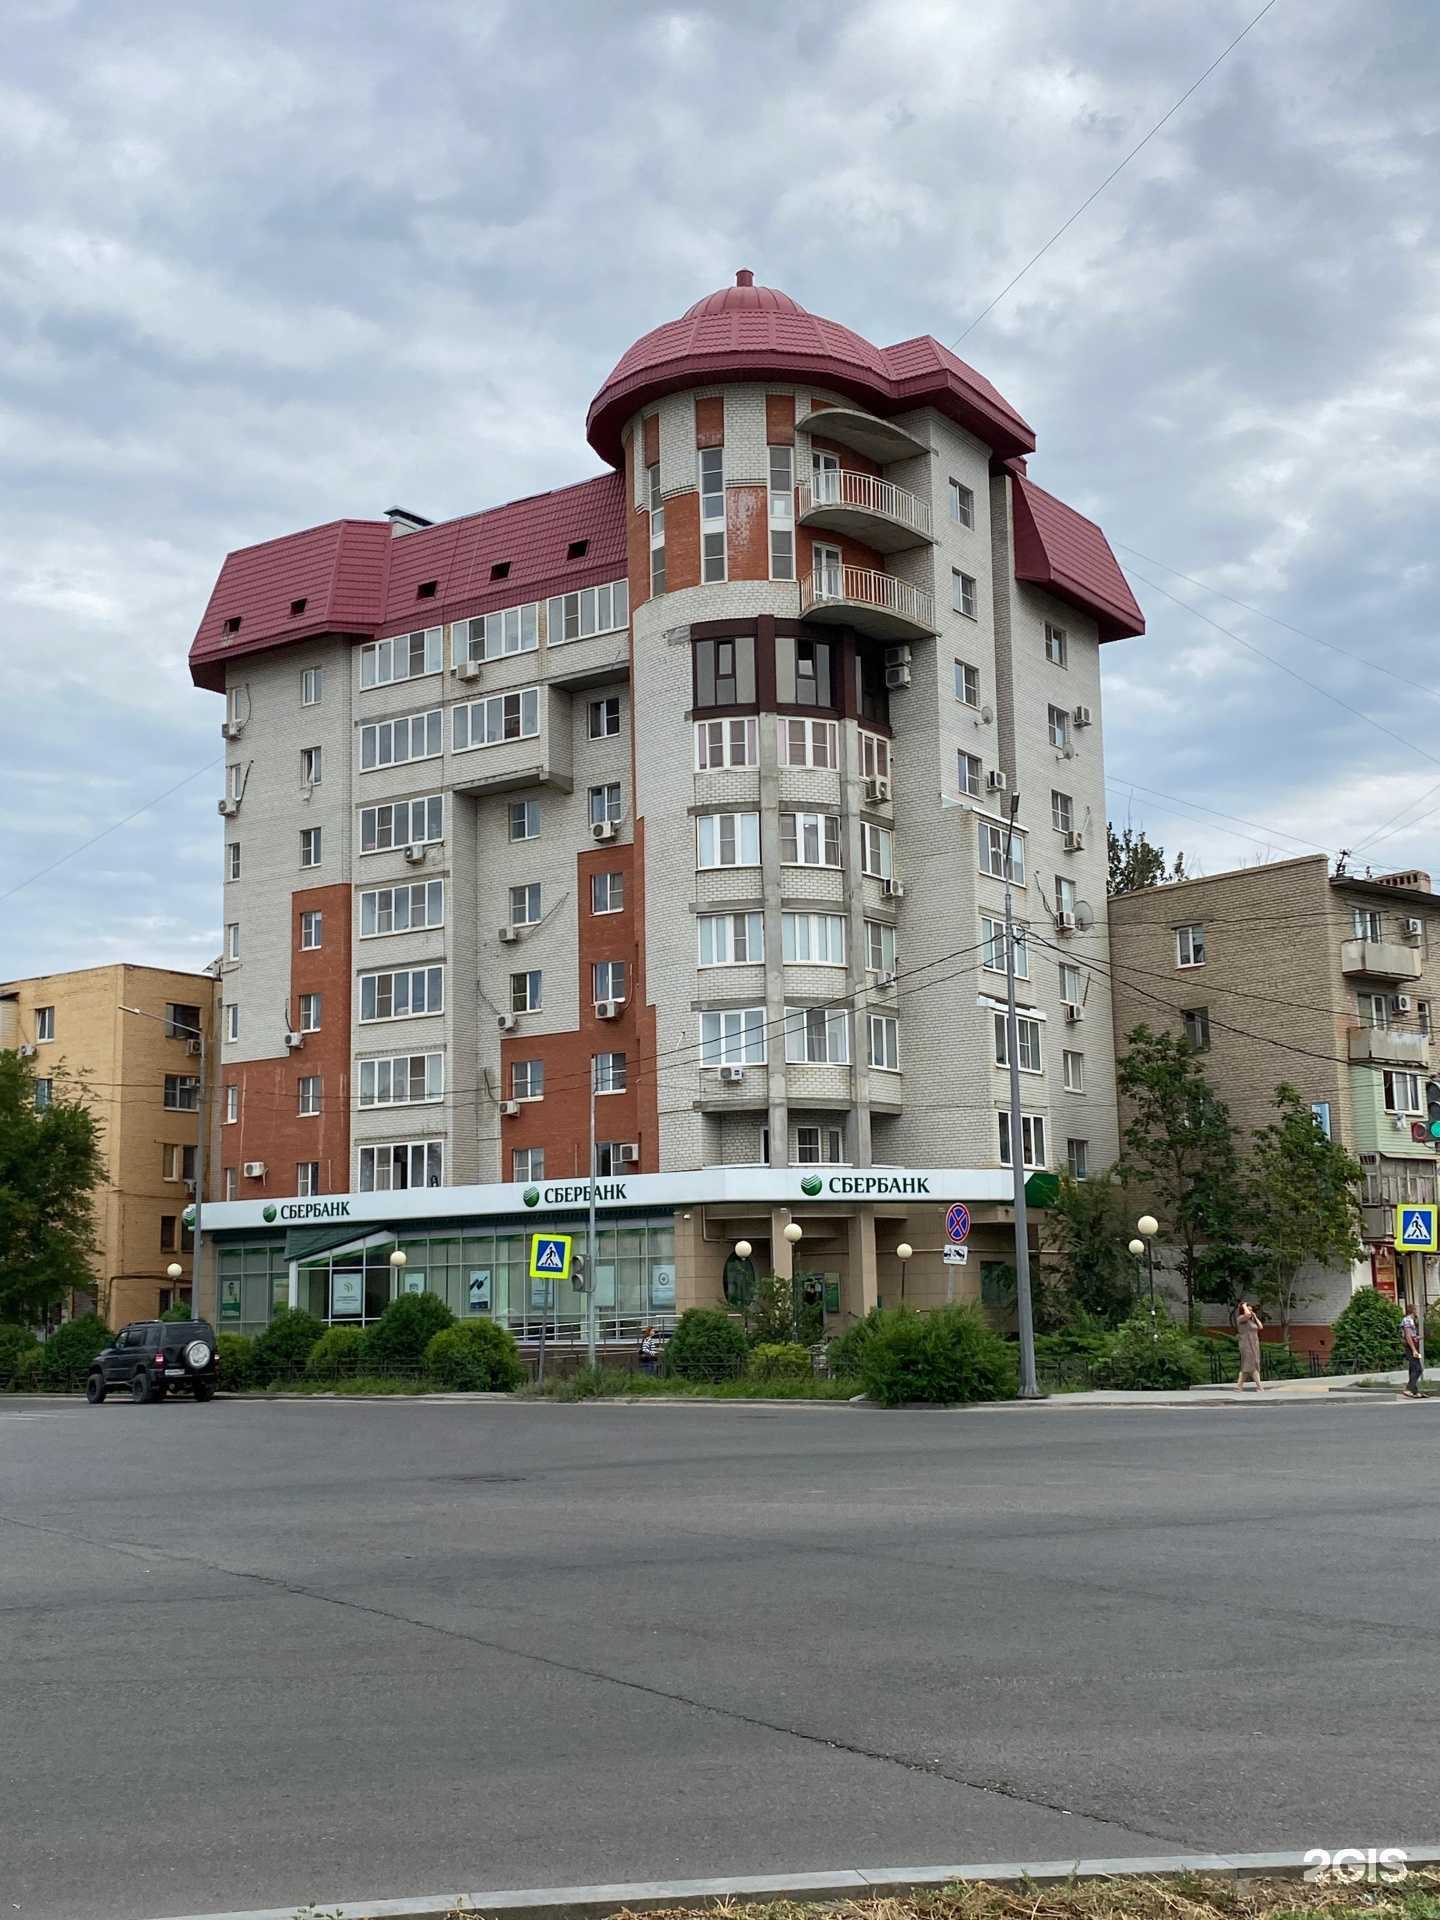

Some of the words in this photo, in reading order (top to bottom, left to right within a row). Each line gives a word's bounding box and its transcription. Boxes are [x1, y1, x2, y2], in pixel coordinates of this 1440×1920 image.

[544, 1183, 627, 1203] СБЕРБАНК
[829, 1177, 930, 1193] СБЕРБАНК
[280, 1201, 350, 1219] СБЕРБАНК
